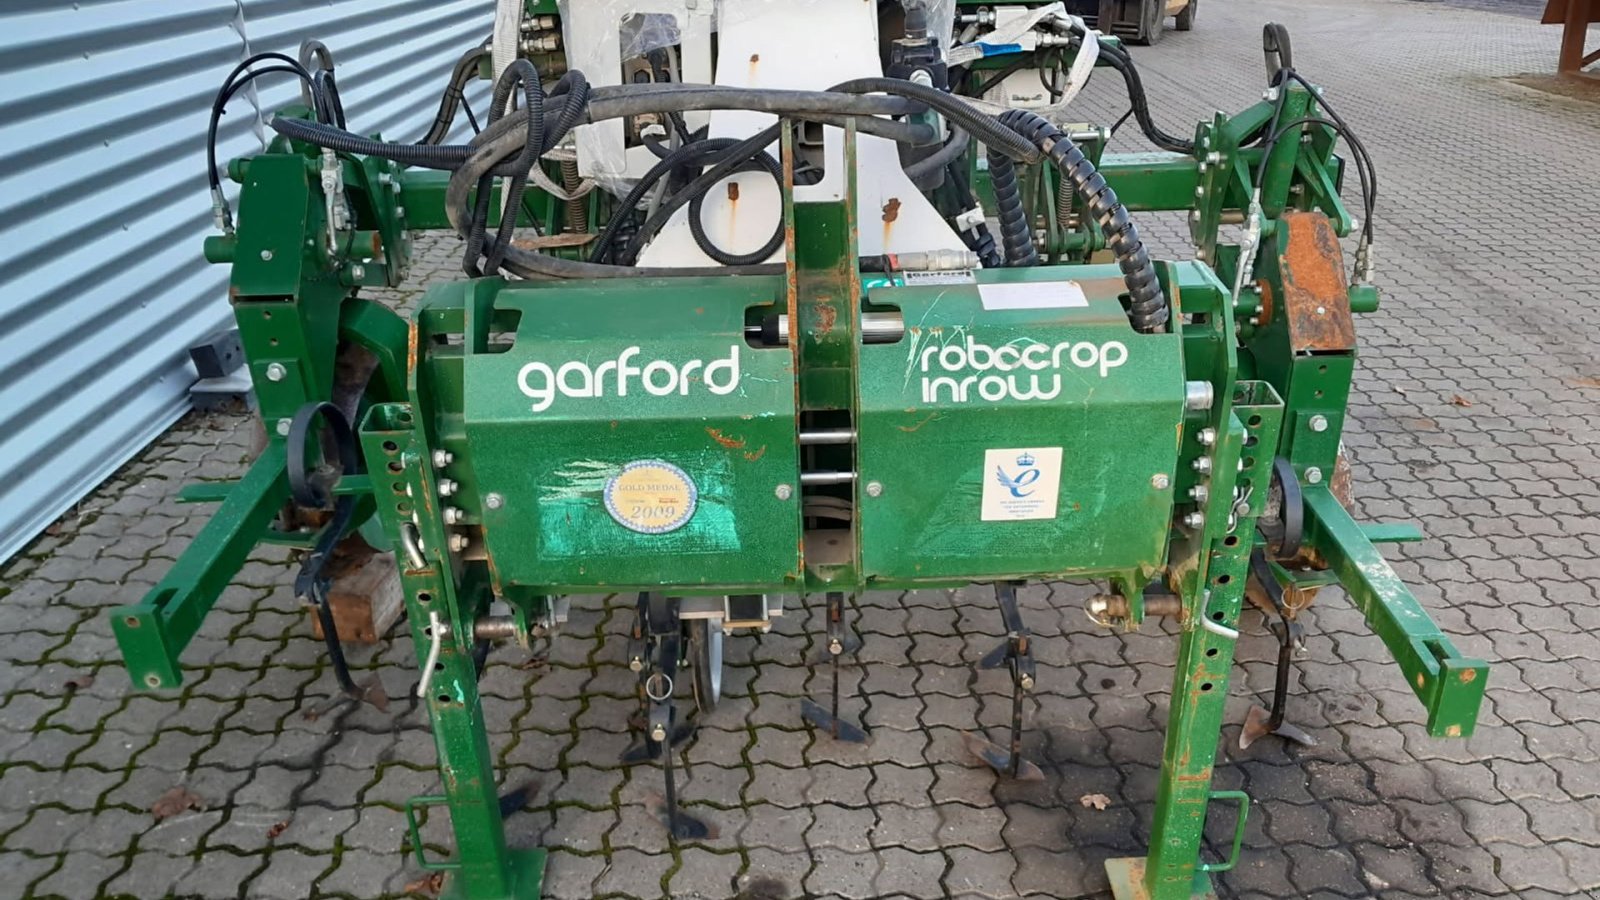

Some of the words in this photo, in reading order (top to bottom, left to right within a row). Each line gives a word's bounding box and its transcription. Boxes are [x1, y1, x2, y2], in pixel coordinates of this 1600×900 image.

[921, 335, 1129, 377] robocrop
[517, 345, 740, 412] garford
[922, 373, 1061, 403] inrow
[619, 484, 645, 492] GOLD
[647, 483, 681, 491] MEDAL
[631, 505, 675, 519] 2009
